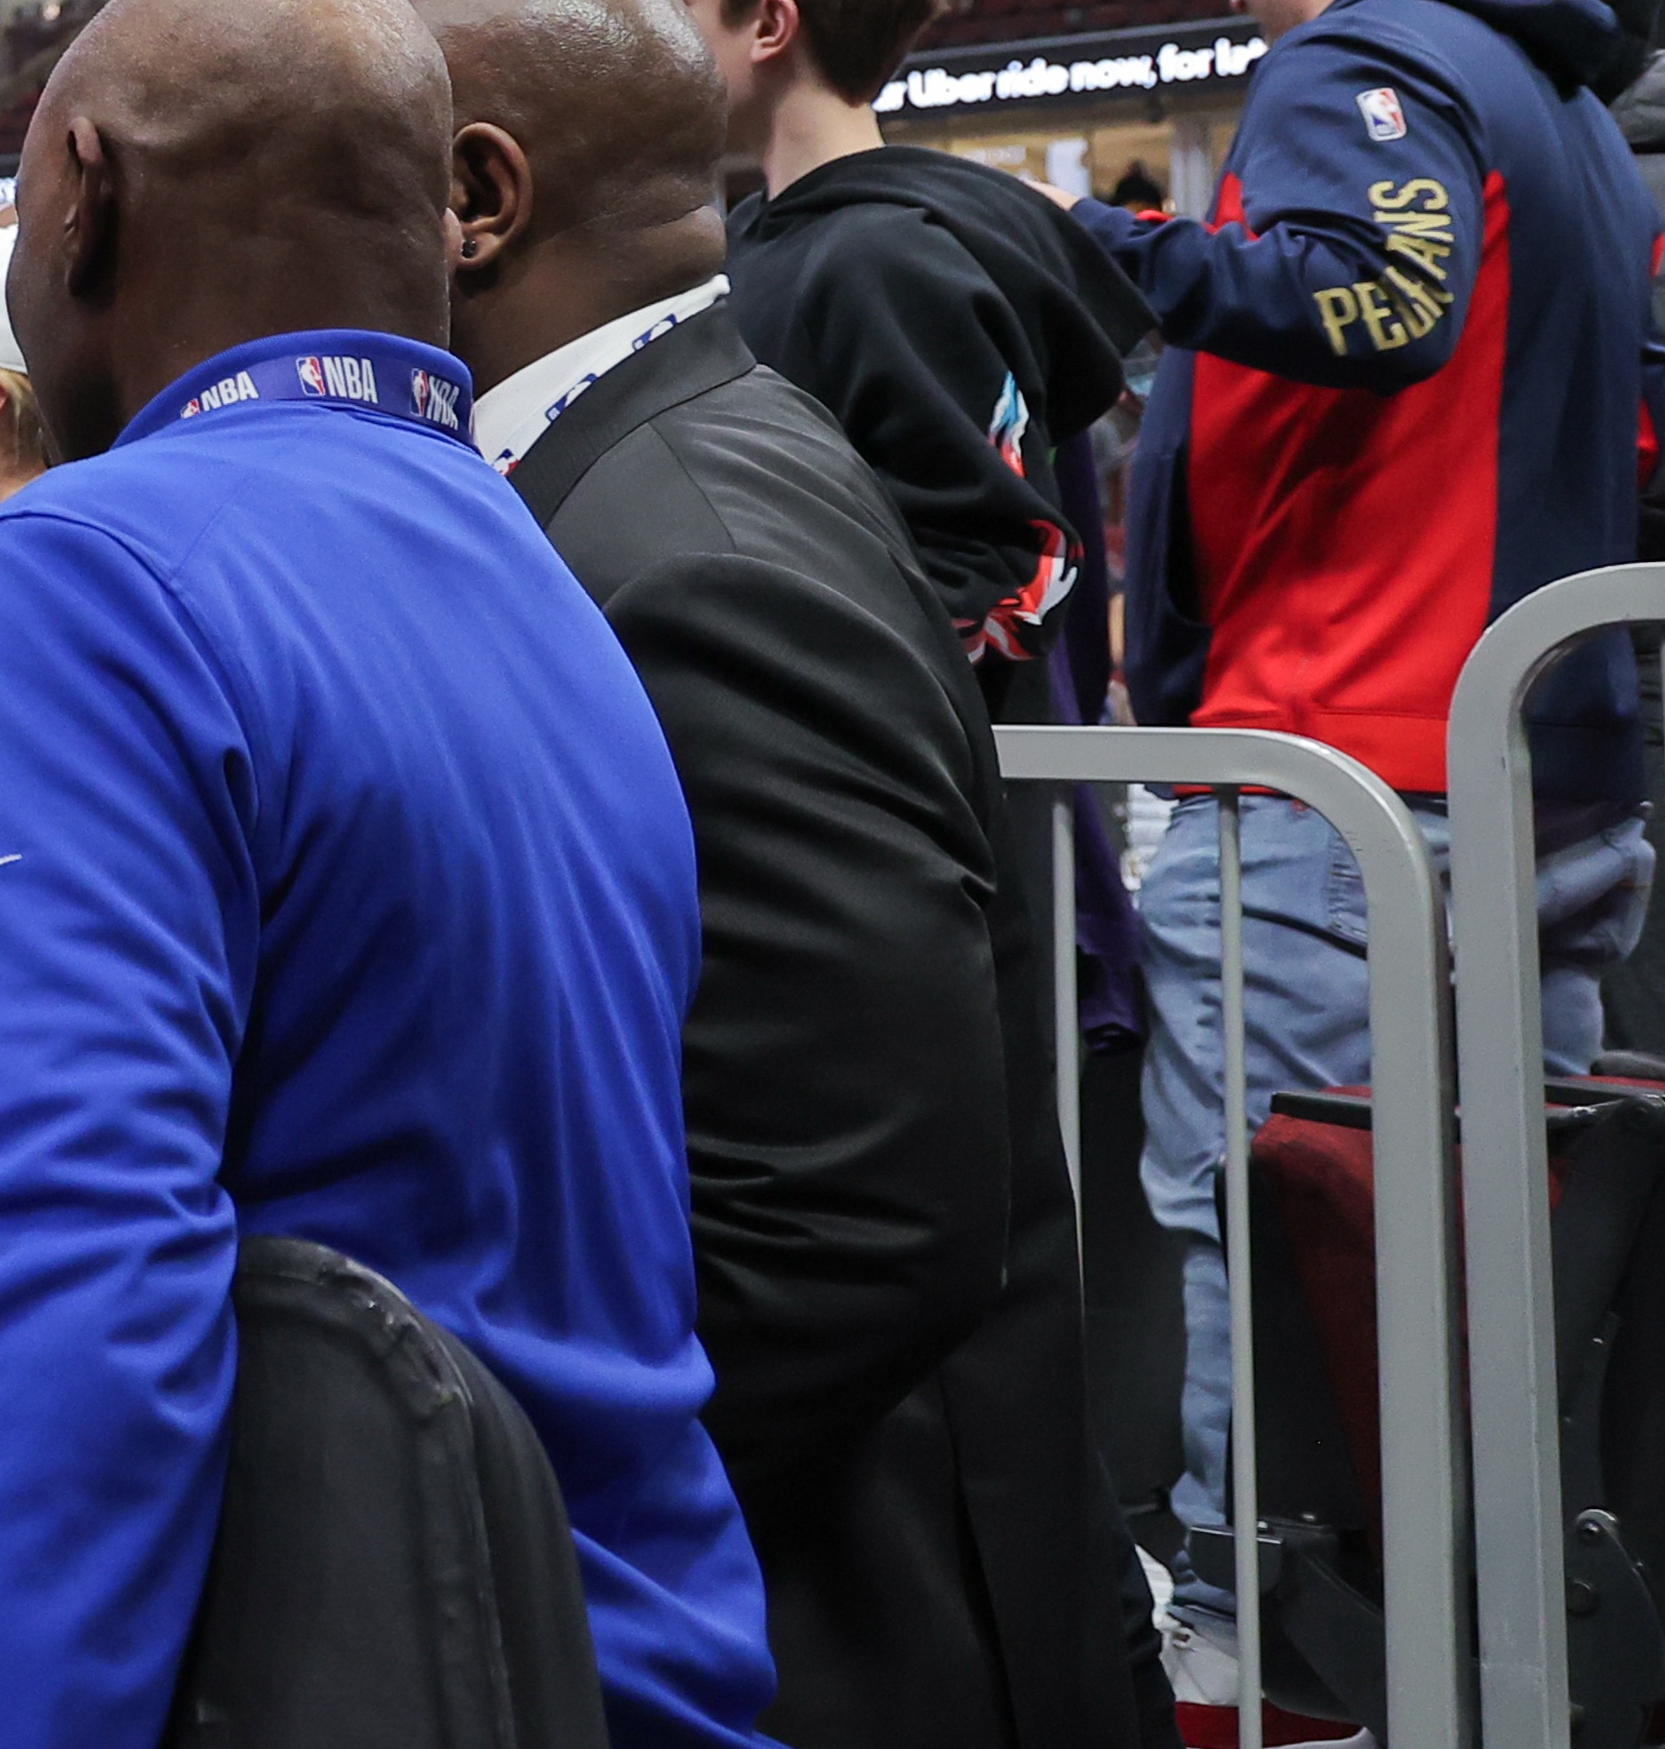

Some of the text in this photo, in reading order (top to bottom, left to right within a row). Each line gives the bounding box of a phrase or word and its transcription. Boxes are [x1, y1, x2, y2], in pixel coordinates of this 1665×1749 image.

[908, 69, 997, 107] Uber
[995, 59, 1072, 98] ride
[1069, 56, 1157, 91] now,
[1158, 44, 1215, 82] for
[200, 355, 460, 431] NBA NBA NBA
